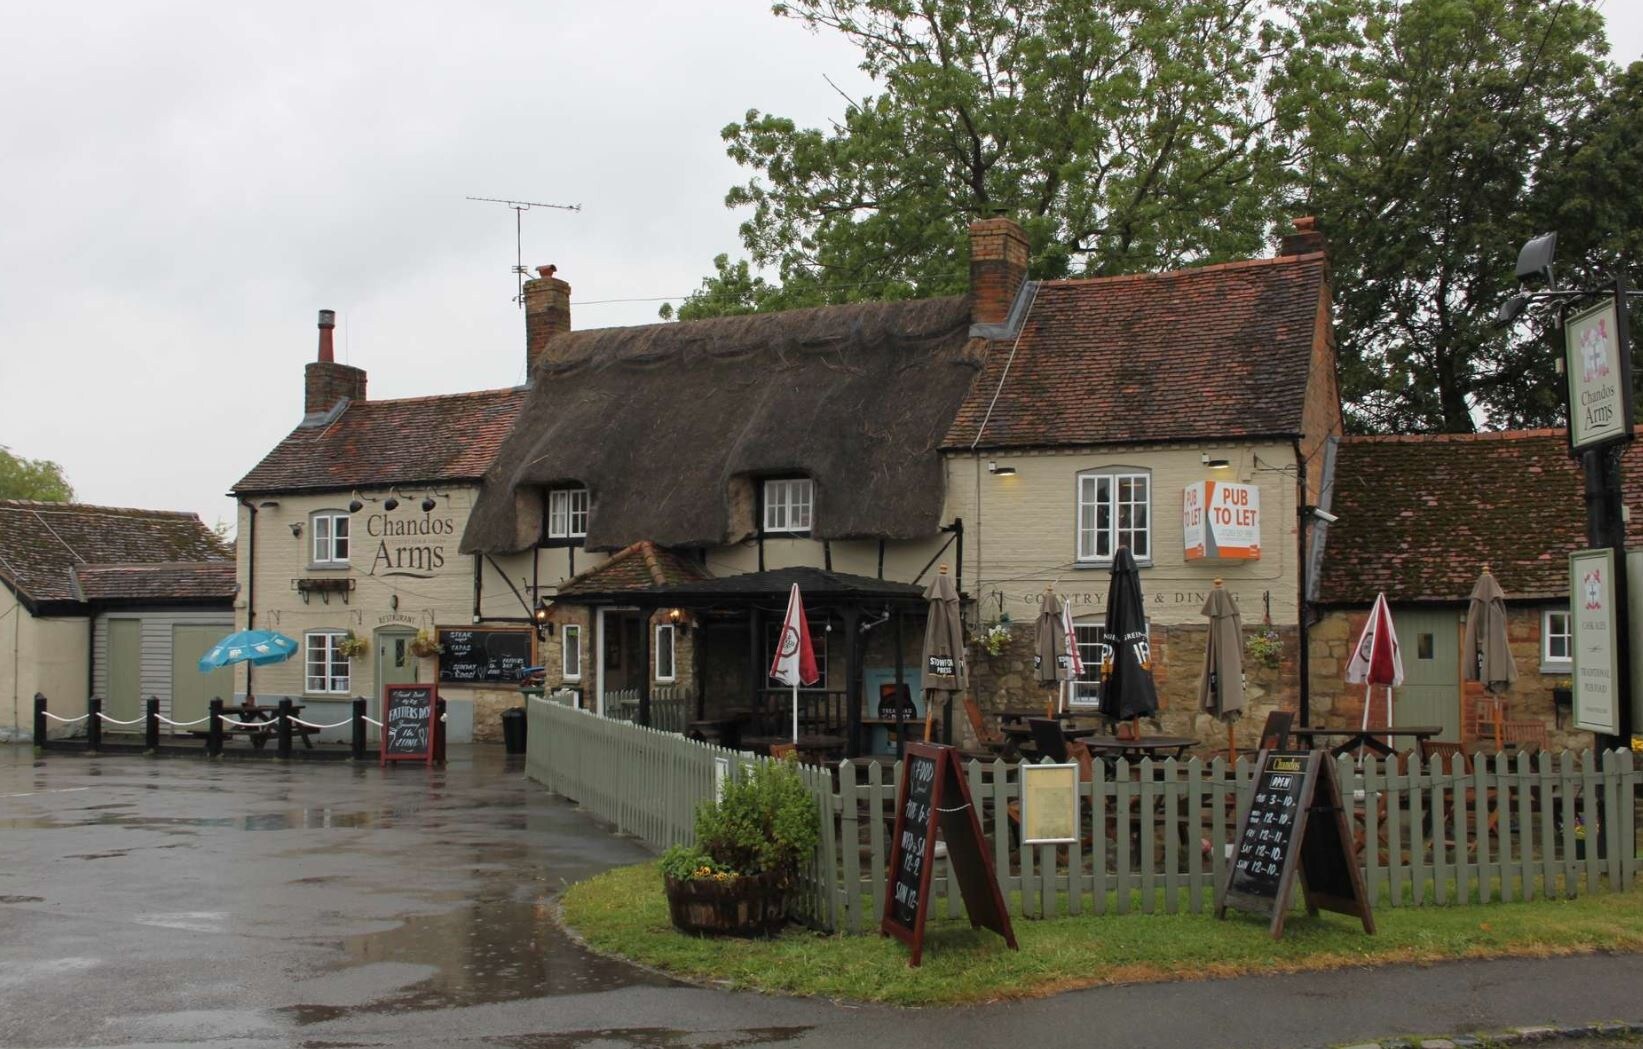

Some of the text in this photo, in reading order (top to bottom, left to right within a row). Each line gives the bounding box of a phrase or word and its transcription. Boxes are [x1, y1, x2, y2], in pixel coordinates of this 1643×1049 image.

[1581, 384, 1615, 406] Chandos
[1584, 402, 1614, 431] Arms
[1186, 488, 1197, 507] PUB
[1223, 488, 1249, 506] PUB
[367, 513, 454, 537] Chandos
[1191, 507, 1202, 526] LET
[1214, 506, 1257, 527] TO LET
[368, 538, 445, 576] Arms
[1024, 592, 1105, 604] CONTRY
[1154, 592, 1165, 604] &
[1175, 592, 1240, 603] DING
[451, 644, 472, 652] TAPAS
[915, 760, 934, 783] FOOD
[1273, 757, 1301, 771] Chandos
[1271, 776, 1292, 788] OPEN
[894, 880, 909, 904] SUN
